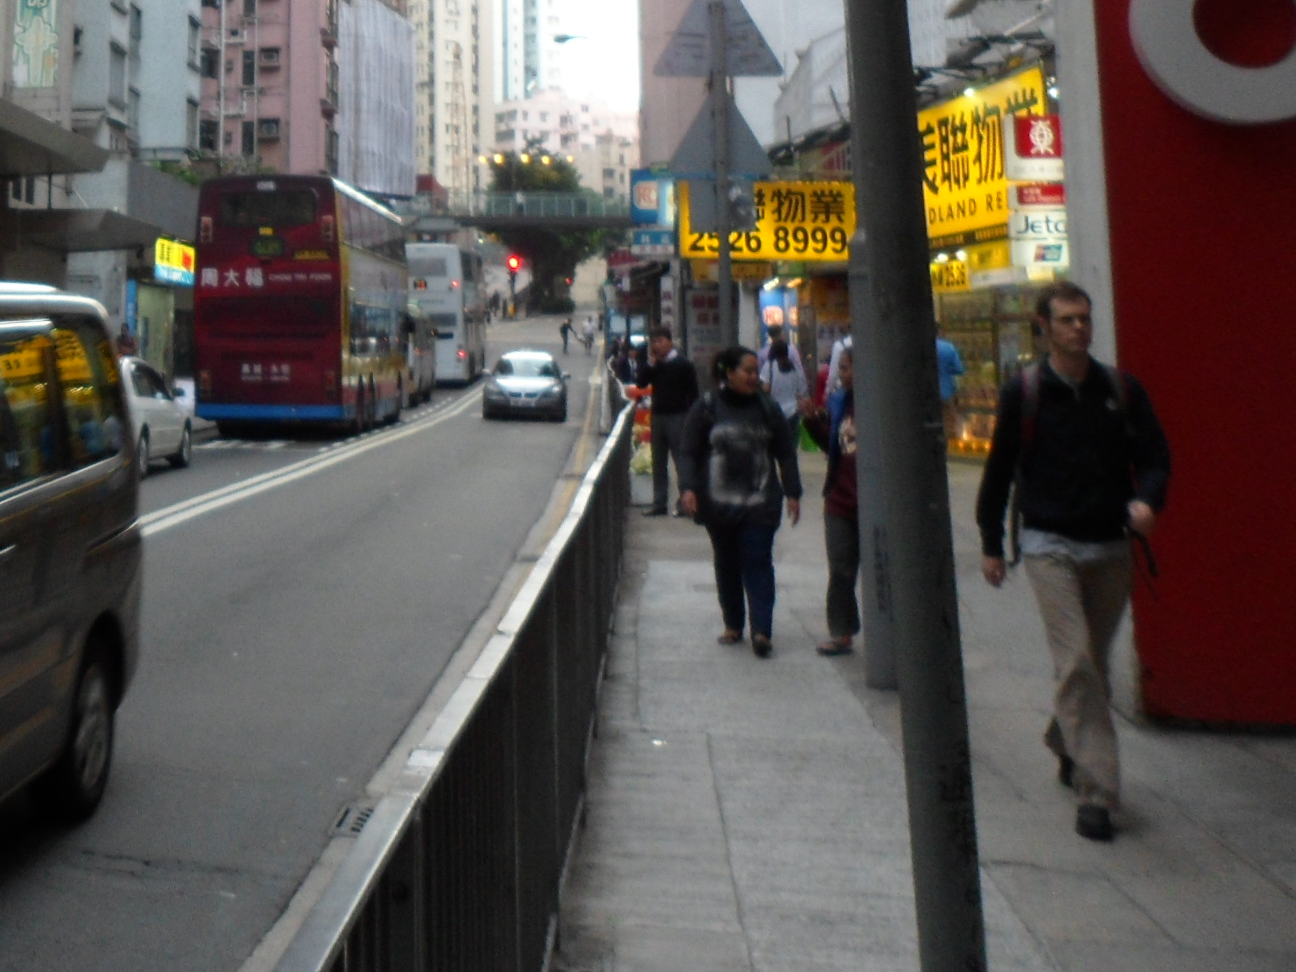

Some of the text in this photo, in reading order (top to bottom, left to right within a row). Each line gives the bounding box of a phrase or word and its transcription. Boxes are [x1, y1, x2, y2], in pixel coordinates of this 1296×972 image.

[755, 188, 845, 224] 物業
[689, 230, 762, 254] 2526
[773, 226, 847, 254] 8999
